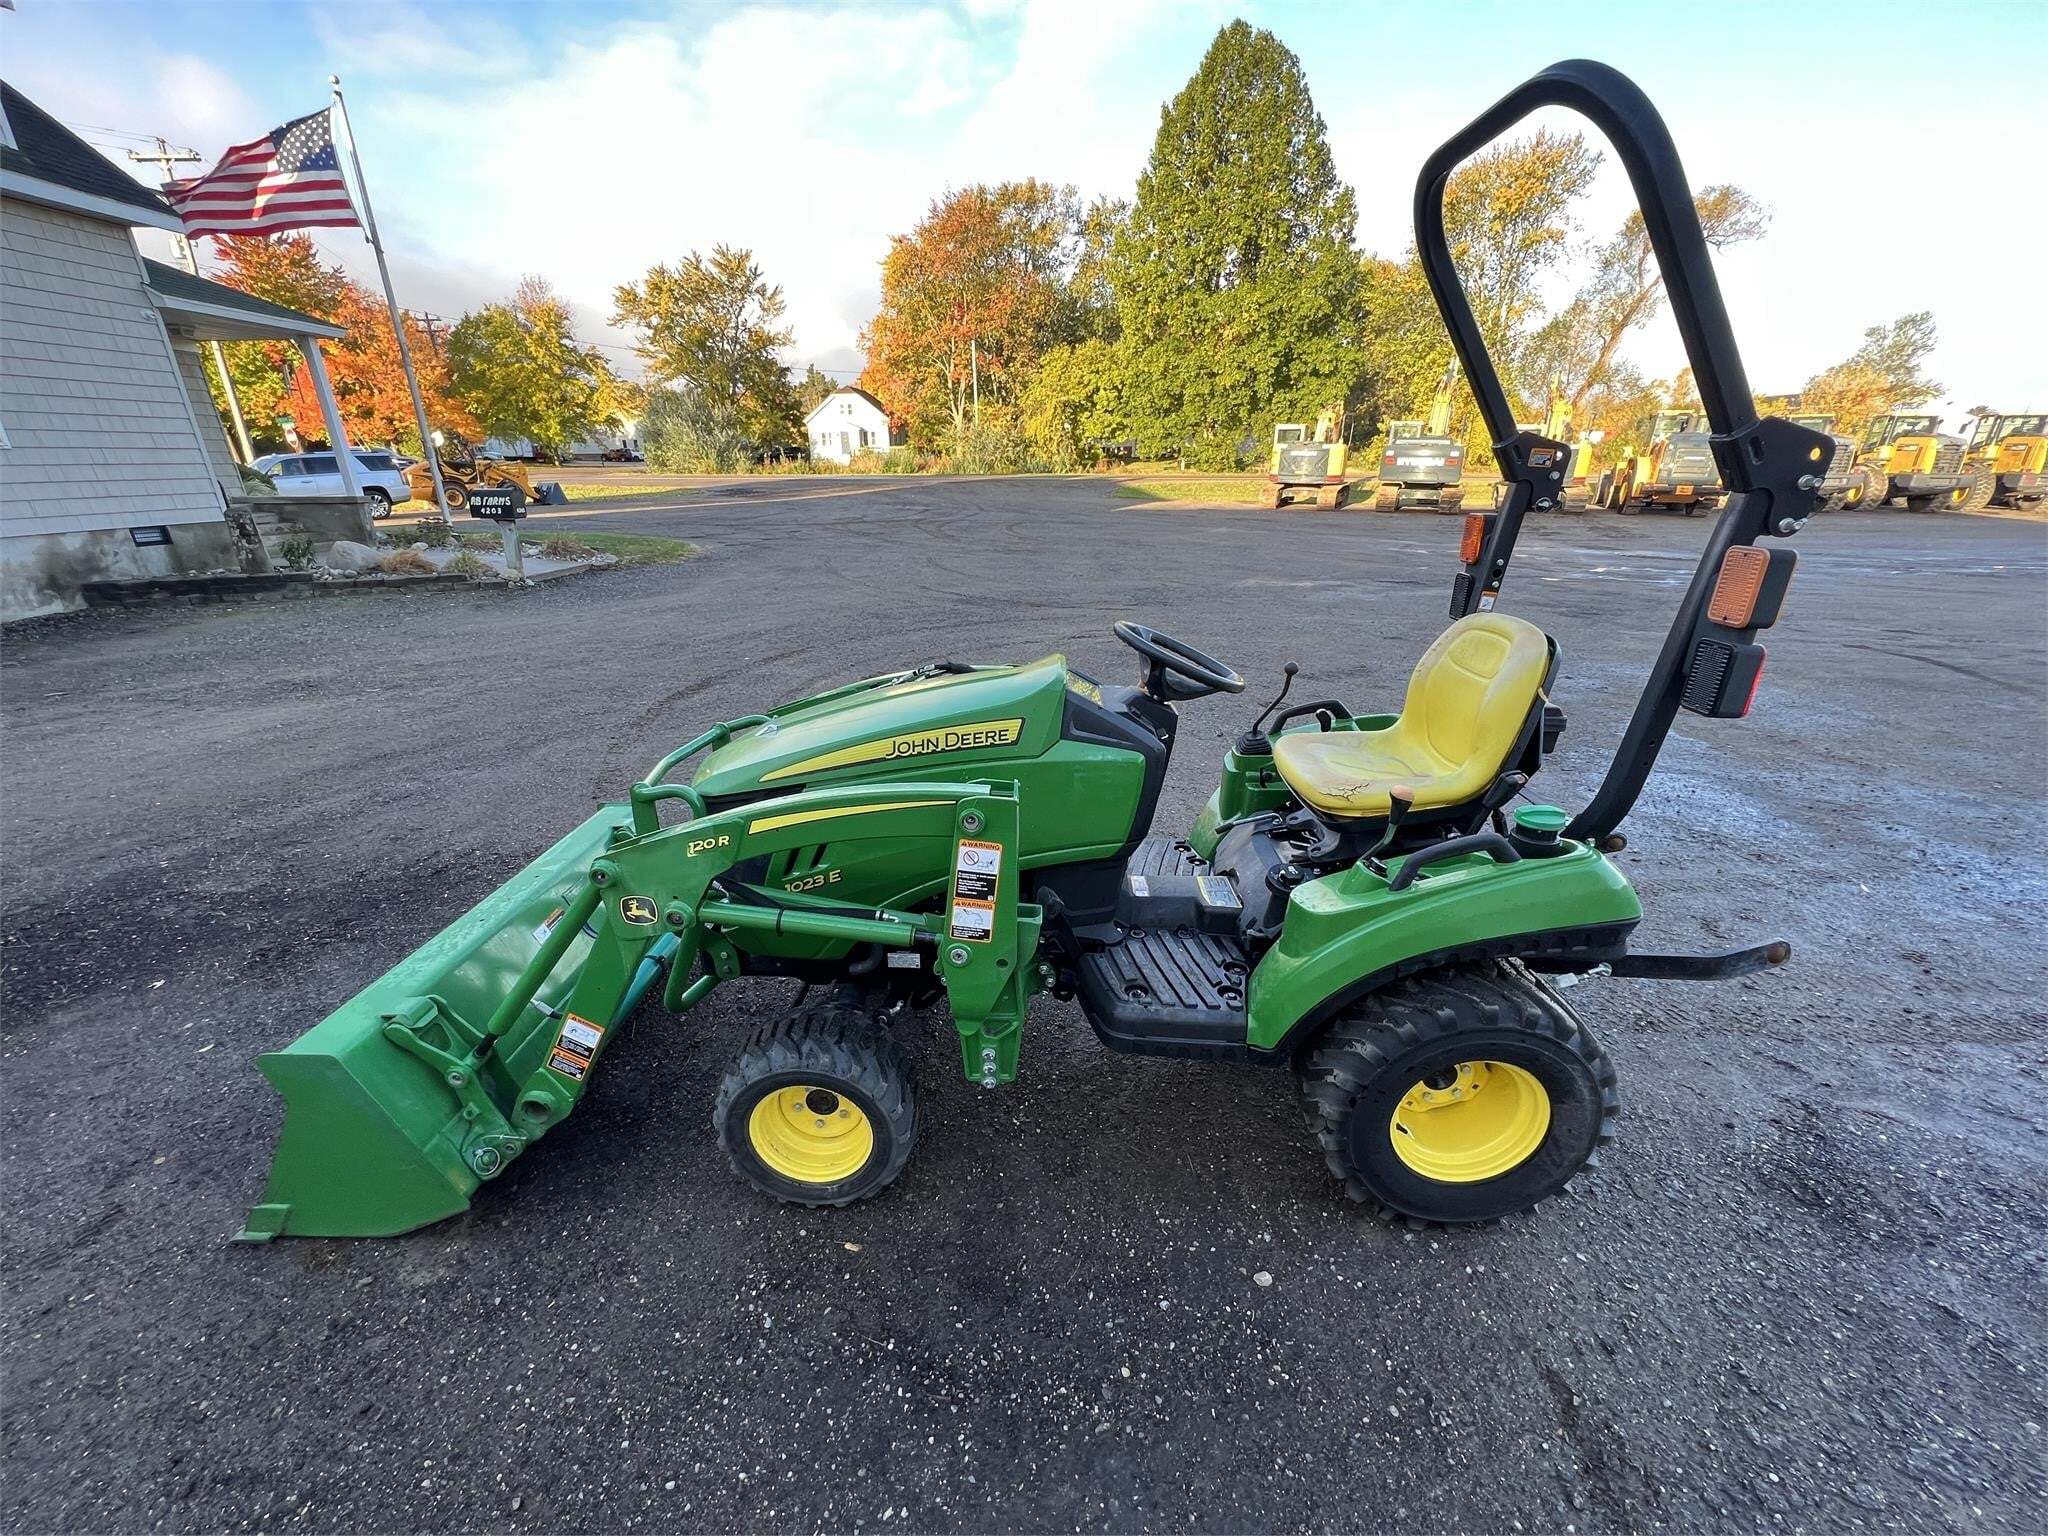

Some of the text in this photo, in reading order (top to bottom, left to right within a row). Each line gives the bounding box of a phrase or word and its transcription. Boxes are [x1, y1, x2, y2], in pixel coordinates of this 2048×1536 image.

[482, 496, 511, 505] FARMS
[886, 729, 1009, 757] JOHN DEERE
[718, 836, 730, 847] R
[967, 841, 1000, 851] WARNING
[785, 870, 841, 892] 1023 E
[960, 901, 993, 910] WARNING
